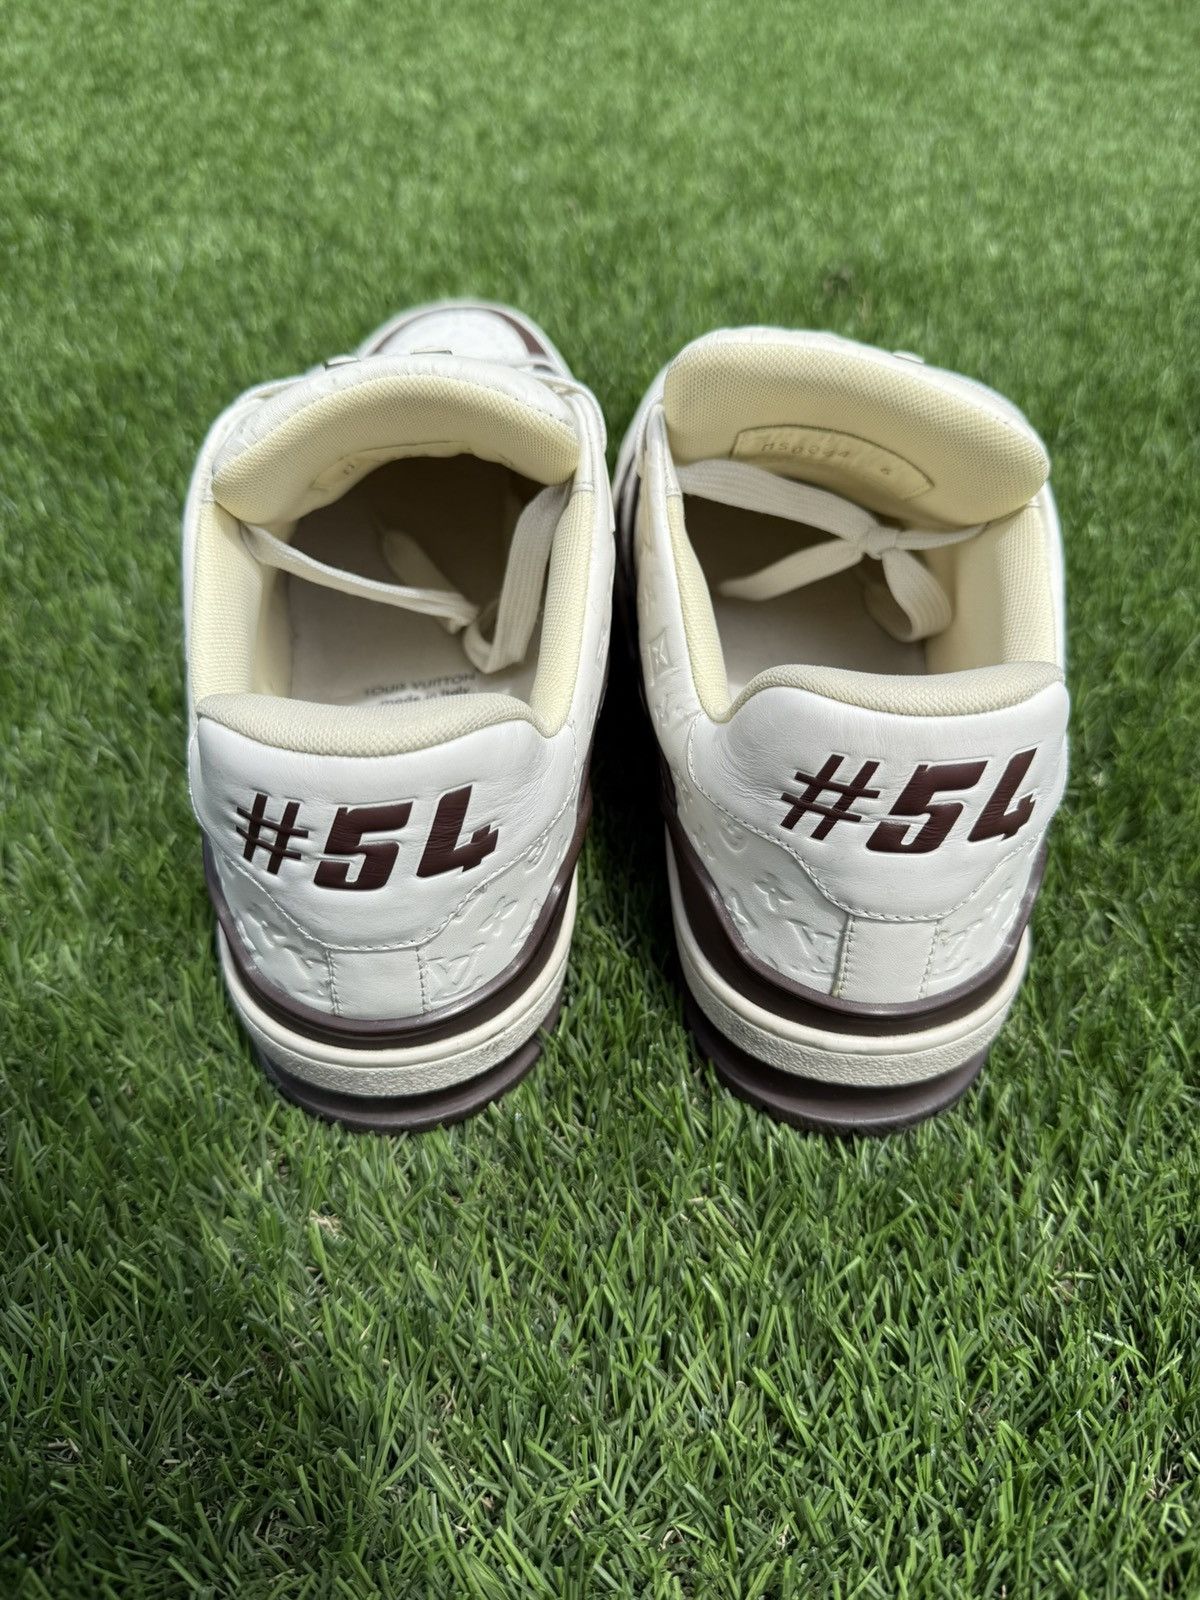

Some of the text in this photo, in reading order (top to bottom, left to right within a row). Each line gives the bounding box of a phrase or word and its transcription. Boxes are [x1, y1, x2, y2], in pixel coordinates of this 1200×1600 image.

[412, 673, 476, 689] VUITTON
[235, 785, 500, 892] #54
[780, 747, 1037, 854] #54
